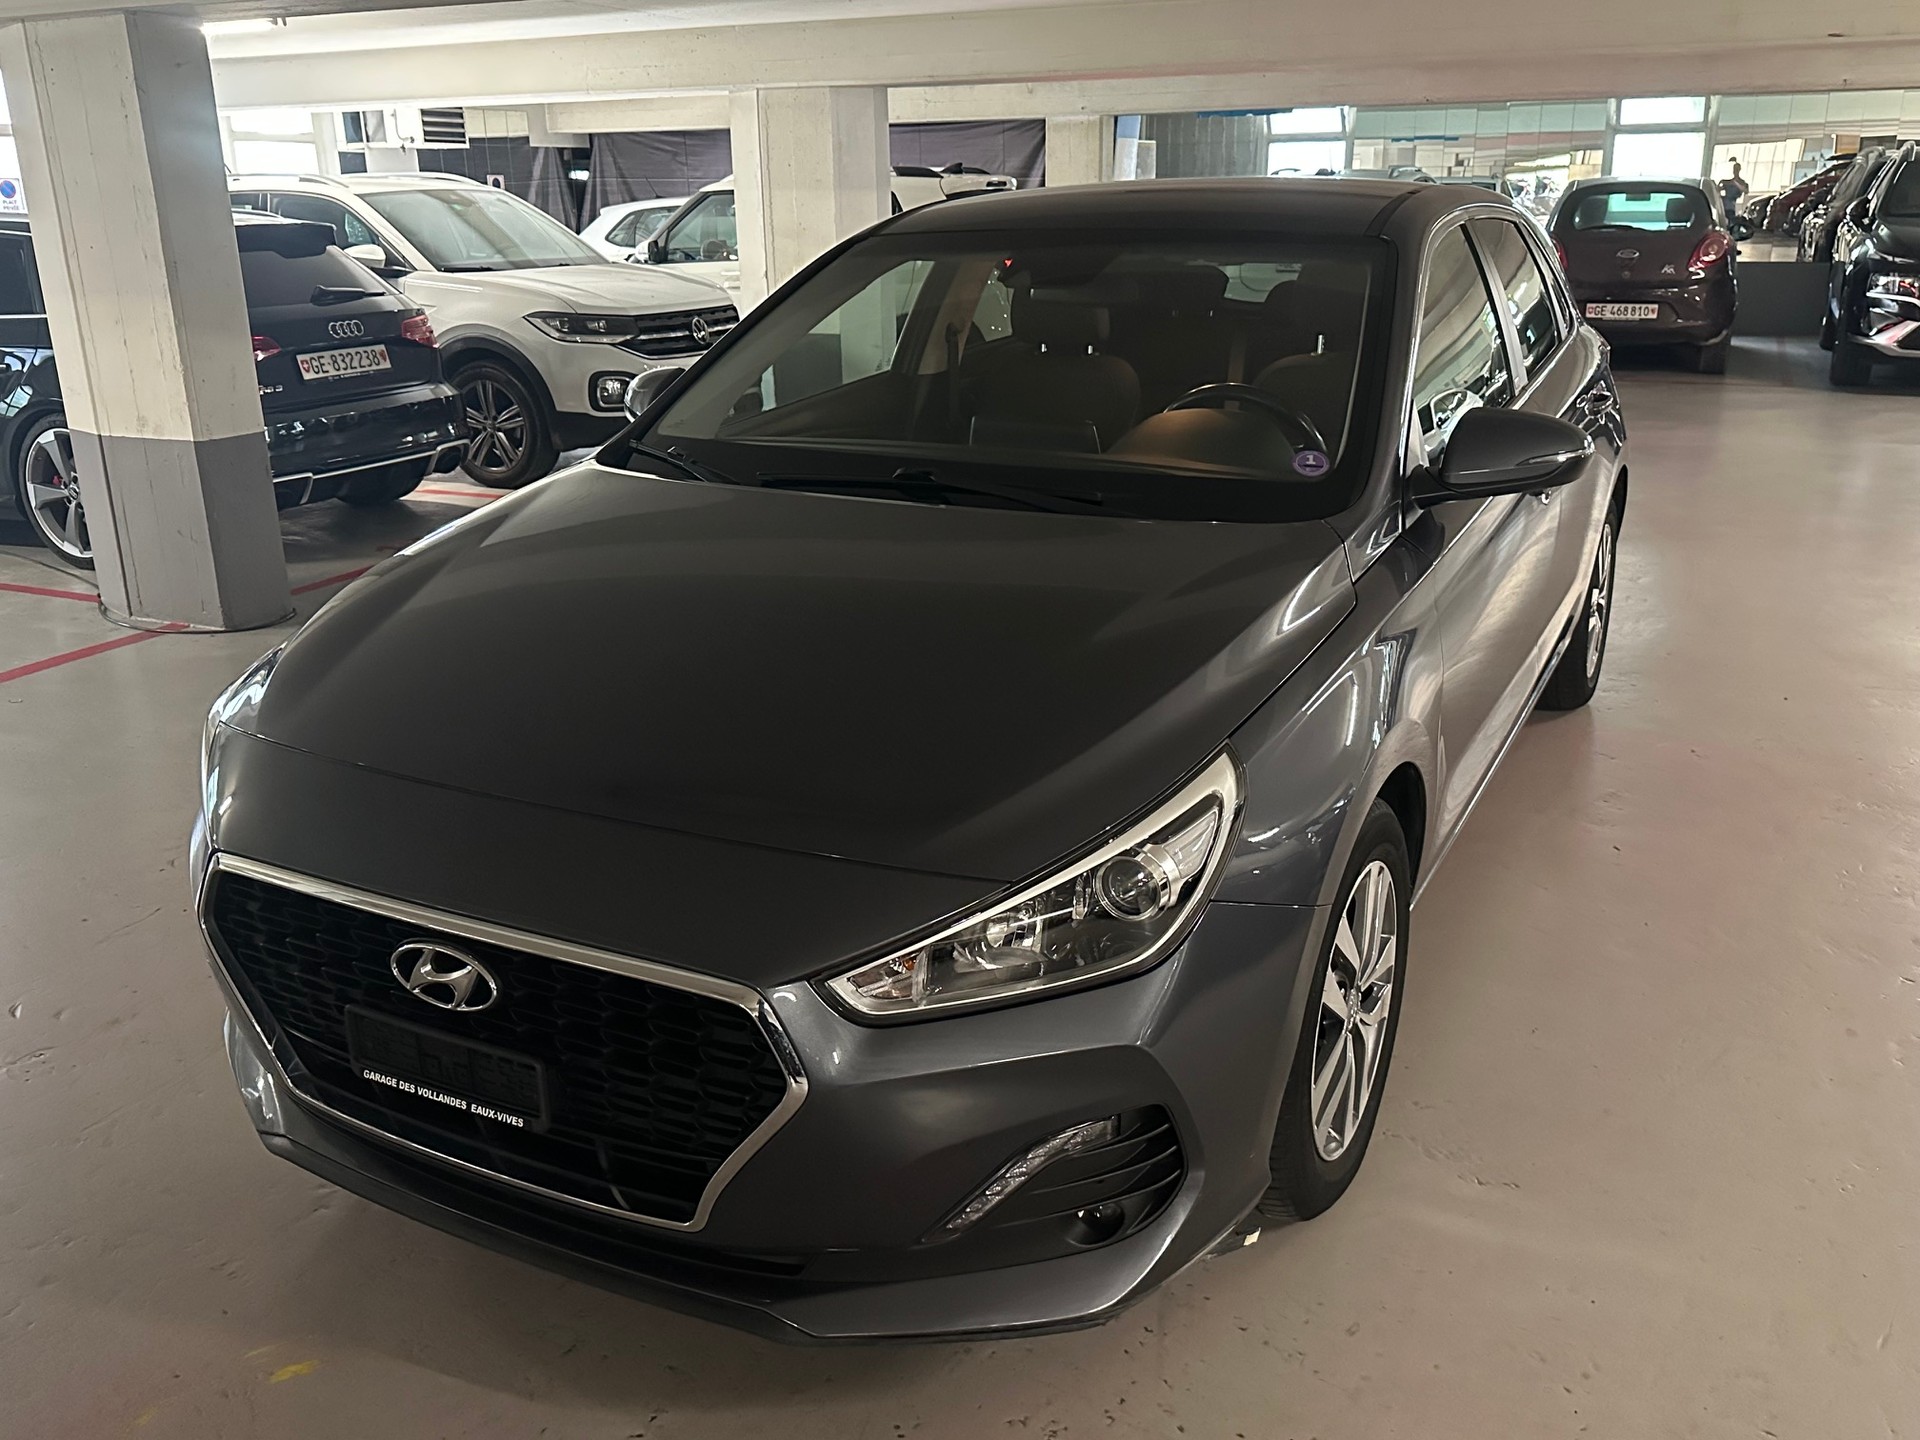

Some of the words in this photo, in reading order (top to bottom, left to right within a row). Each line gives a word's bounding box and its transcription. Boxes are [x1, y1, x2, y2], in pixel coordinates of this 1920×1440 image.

[1305, 454, 1316, 465] 1
[363, 1069, 398, 1088] GARAGE
[399, 1080, 416, 1094] DES
[417, 1086, 467, 1110] VOLLANDES
[470, 1103, 524, 1128] EAUX-VIVES
